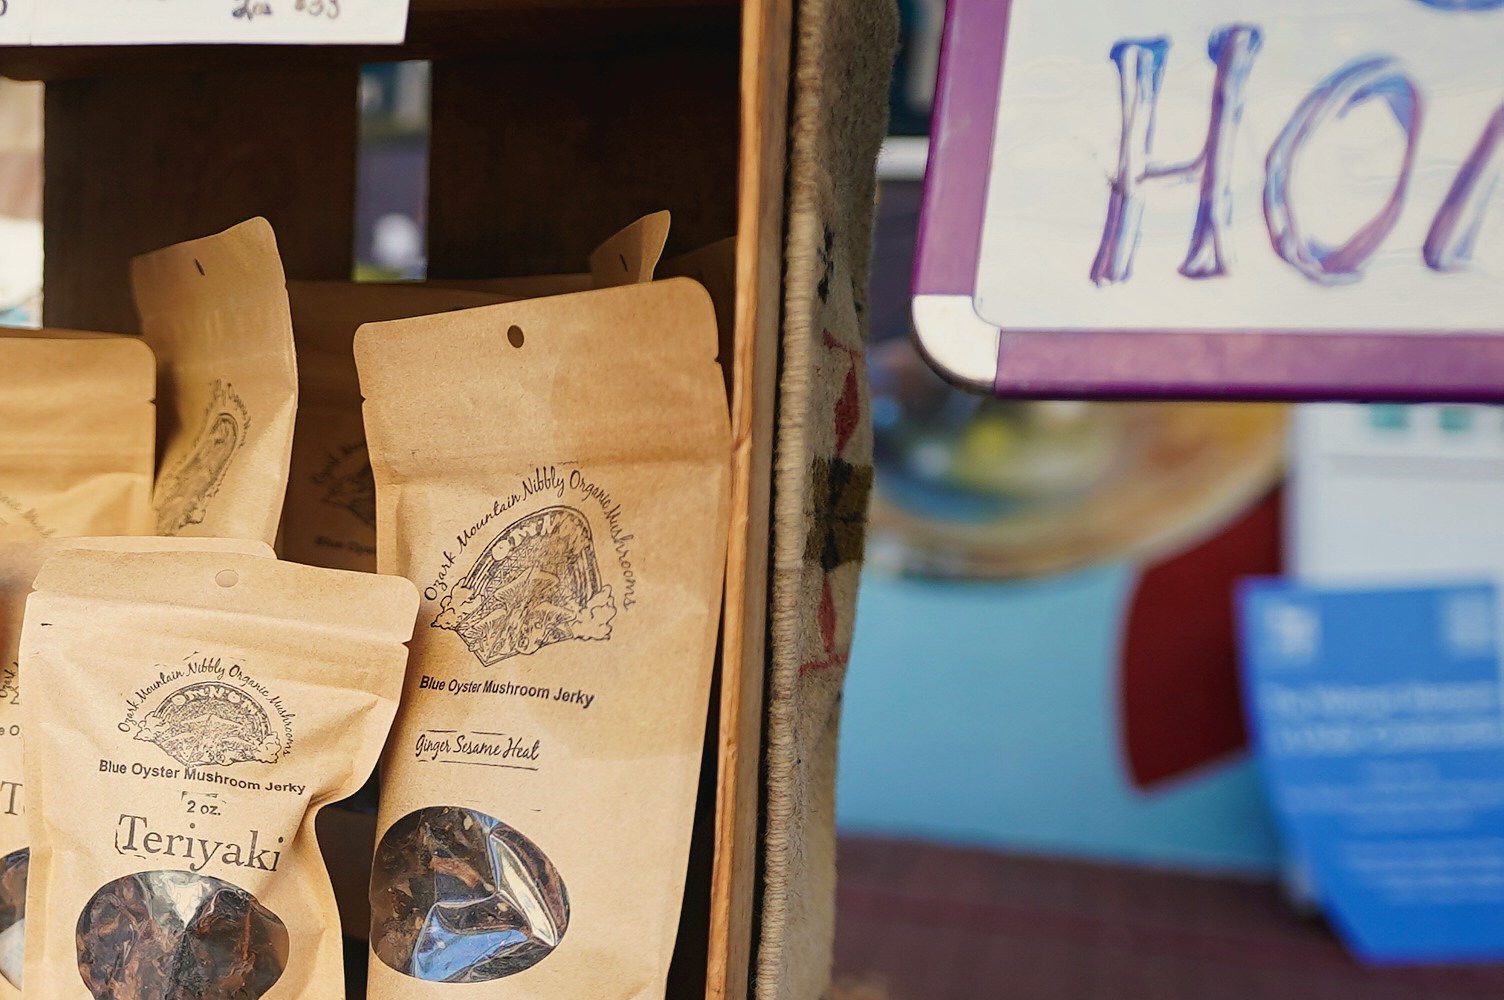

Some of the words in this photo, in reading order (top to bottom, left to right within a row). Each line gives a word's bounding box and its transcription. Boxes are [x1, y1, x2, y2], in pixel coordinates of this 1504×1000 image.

[424, 551, 456, 601] Ozark
[457, 493, 522, 555] Mountain
[522, 466, 566, 502] Nibbly
[569, 469, 610, 510] Organic
[604, 503, 638, 611] Mushrooms
[117, 700, 141, 733] Ozark
[138, 669, 186, 705] Mountain
[185, 657, 226, 681] Nibbly
[228, 664, 270, 698] Organic
[267, 695, 297, 758] Mushrooms
[419, 675, 446, 691] Blue
[448, 679, 482, 695] Oyster
[482, 680, 550, 700] Mushroom
[553, 687, 595, 709] Jerky
[415, 734, 451, 761] Ginger
[453, 734, 502, 757] Sesame
[501, 736, 541, 761] Heat
[98, 759, 127, 774] Blue
[131, 762, 180, 780] Oyster
[184, 767, 261, 791] Mushroom
[264, 782, 306, 796] Jerky
[186, 799, 196, 813] 2
[200, 804, 222, 816] oz.
[118, 813, 285, 872] Teriyaki
